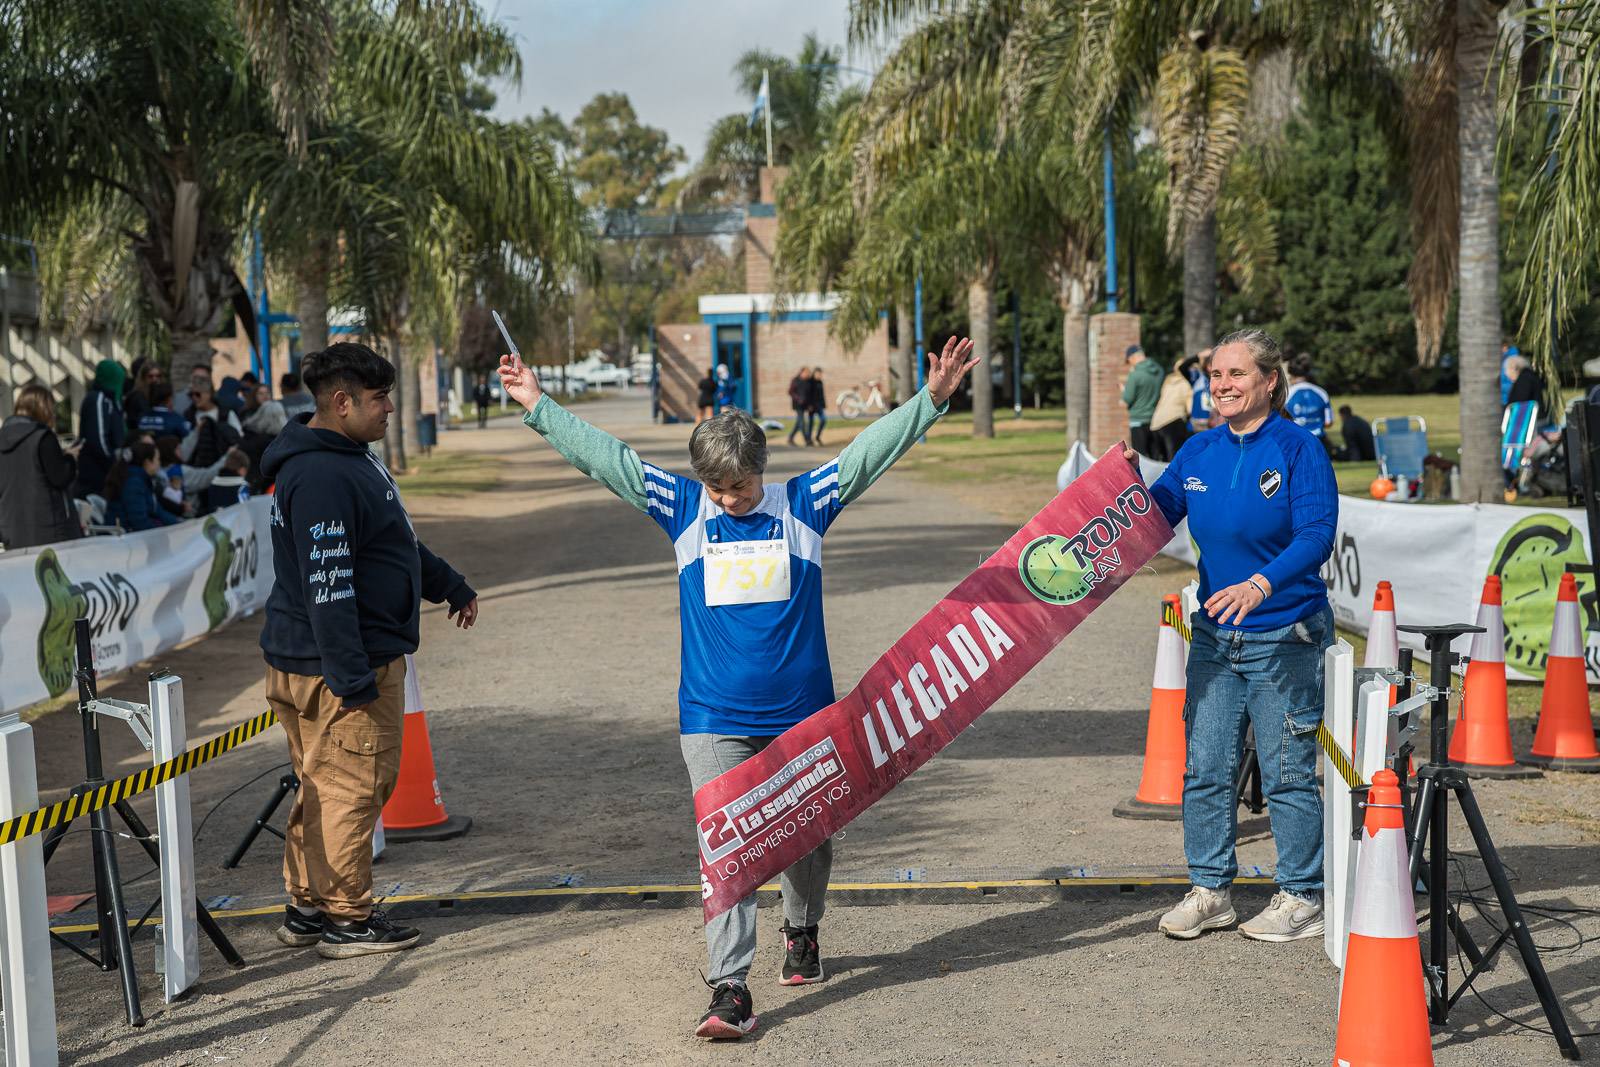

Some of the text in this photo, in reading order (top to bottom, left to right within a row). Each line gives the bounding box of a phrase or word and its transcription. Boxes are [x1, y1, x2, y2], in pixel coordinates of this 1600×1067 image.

[310, 521, 326, 540] El
[315, 587, 329, 604] del
[713, 557, 778, 591] 737
[1081, 547, 1122, 589] RAV
[862, 605, 1015, 769] LLEGADA
[732, 744, 830, 814] GRUPO ASEGURADOR
[738, 758, 839, 835] La segunda
[716, 781, 851, 882] LO PRIMERO SOS VOS
